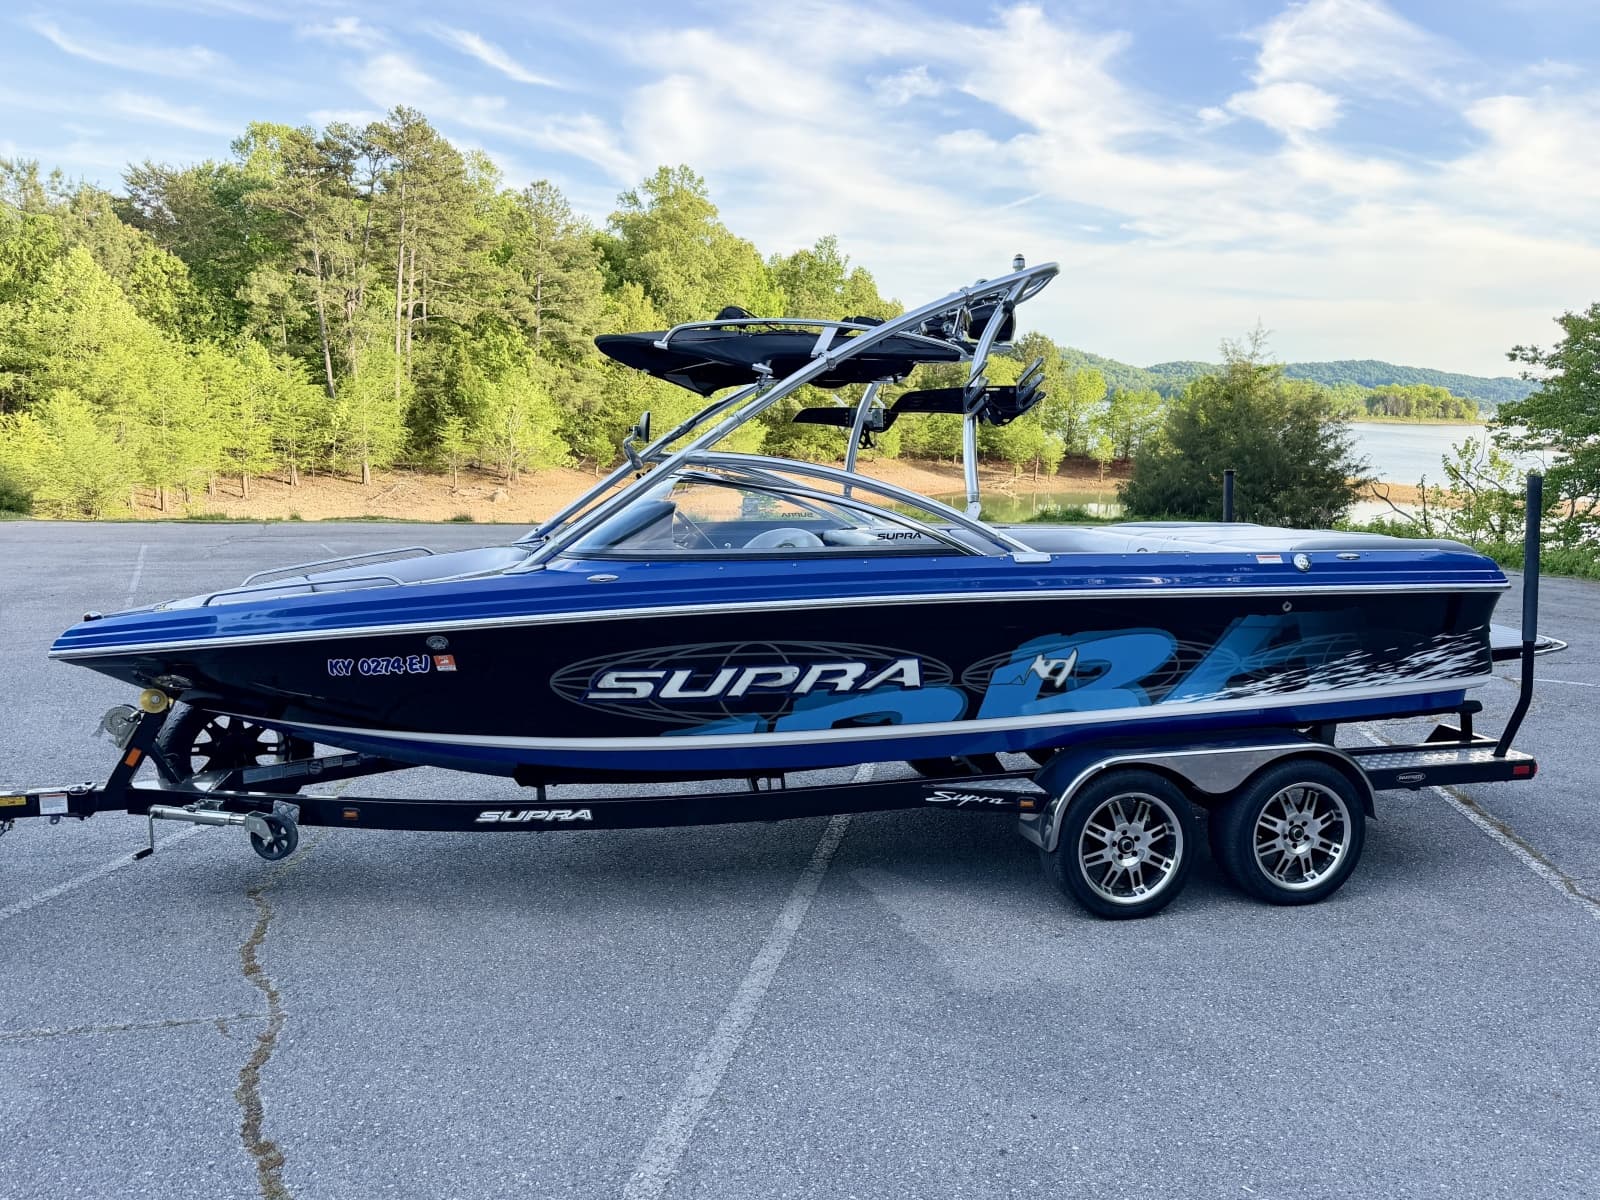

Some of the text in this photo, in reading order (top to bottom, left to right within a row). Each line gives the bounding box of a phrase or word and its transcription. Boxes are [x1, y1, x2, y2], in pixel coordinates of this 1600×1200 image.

[877, 532, 922, 541] SUPRA
[327, 658, 354, 676] KY
[358, 656, 405, 676] 0274
[406, 654, 430, 674] EJ
[585, 657, 922, 700] SUPRA
[925, 791, 1013, 807] Supra
[475, 809, 593, 822] SUPRA
